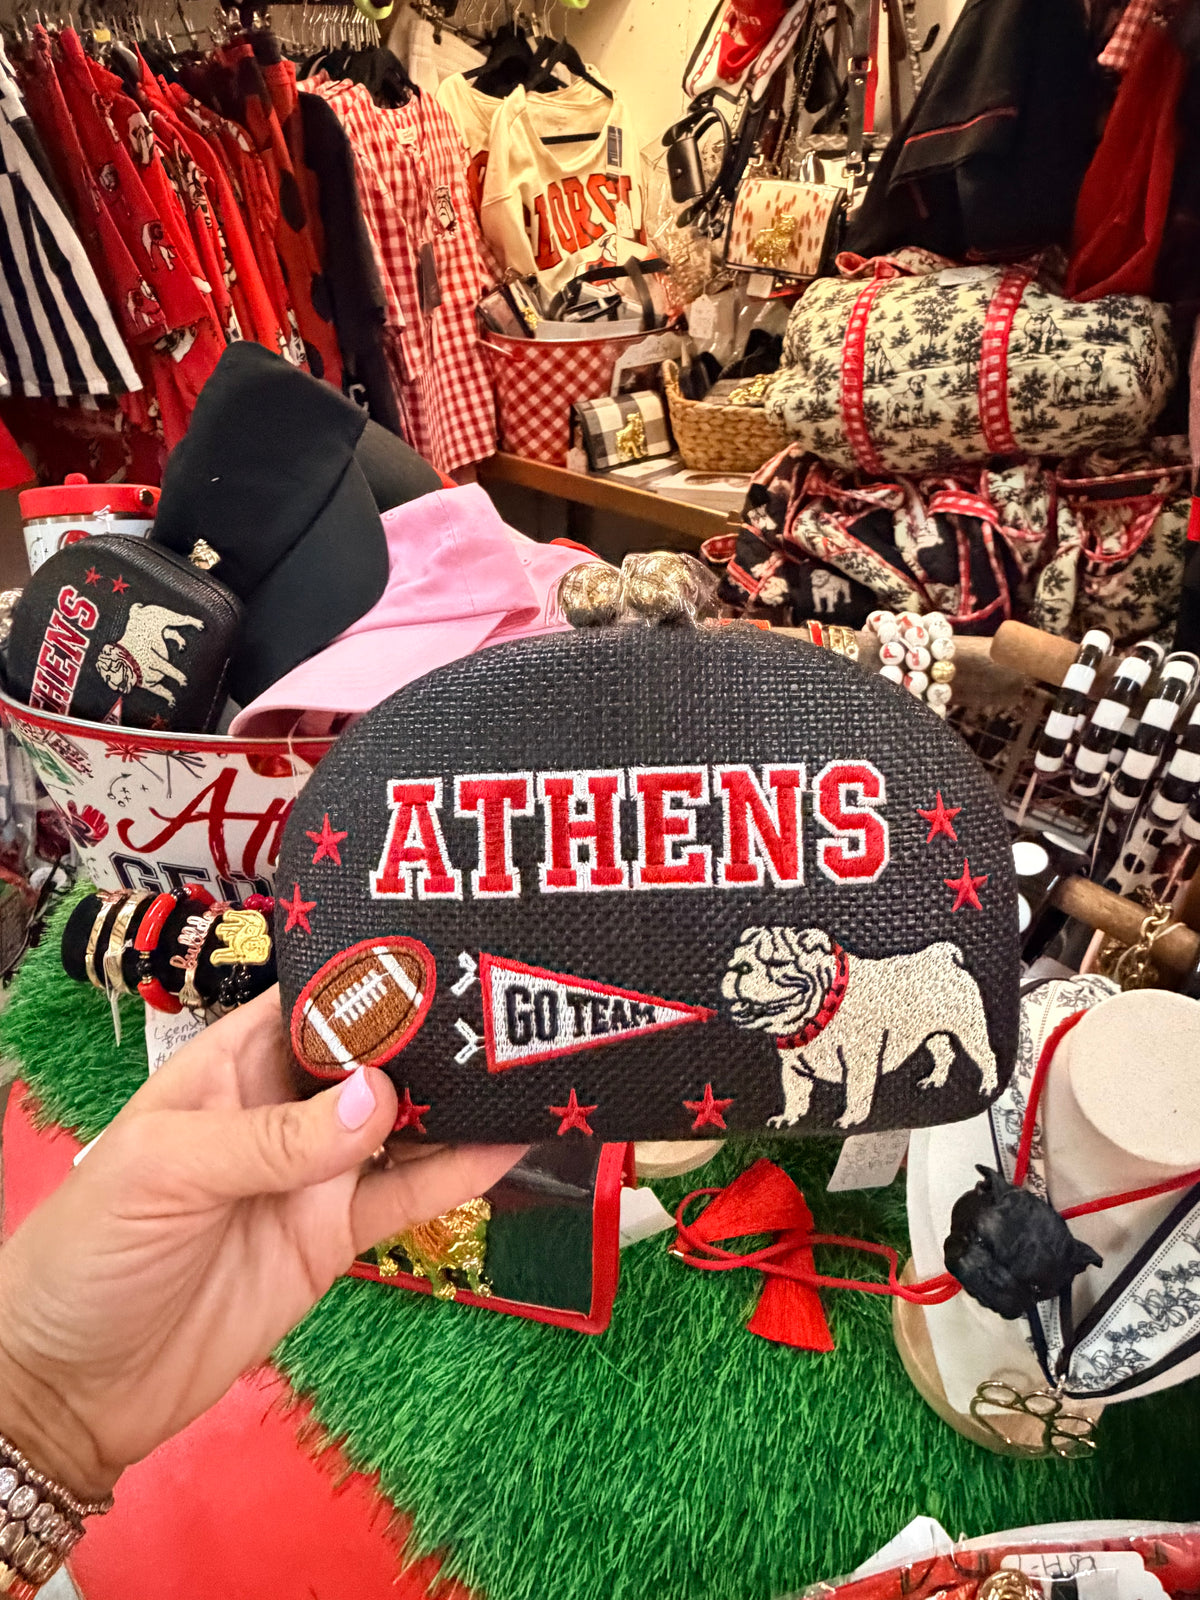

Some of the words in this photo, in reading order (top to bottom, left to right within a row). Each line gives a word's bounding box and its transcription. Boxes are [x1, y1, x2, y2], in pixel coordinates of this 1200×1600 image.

[369, 758, 891, 903] ATHENS
[505, 984, 559, 1046] GO
[566, 992, 656, 1037] TEAM
